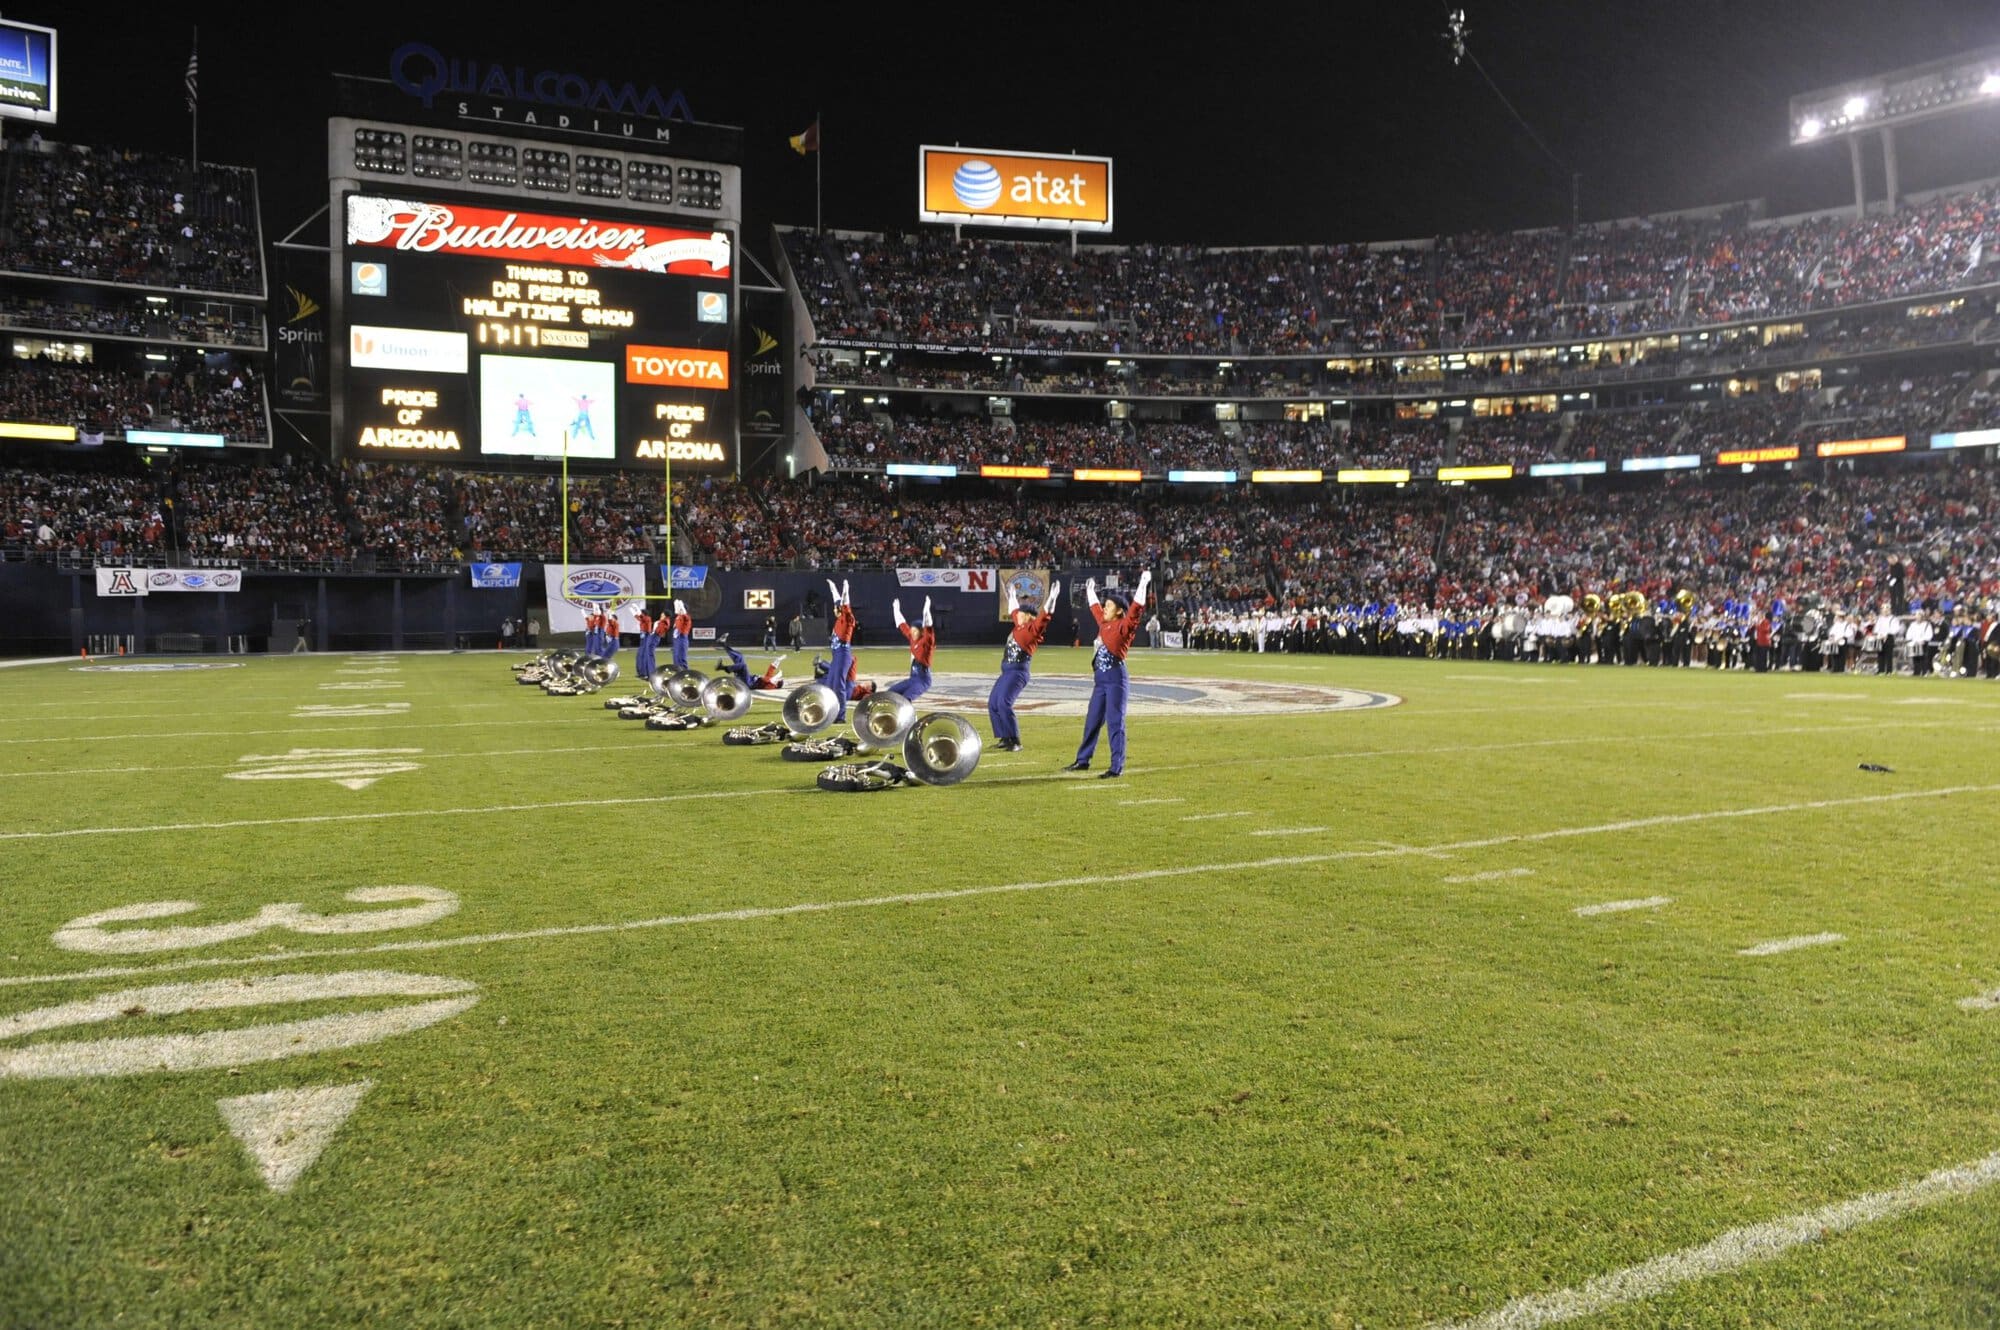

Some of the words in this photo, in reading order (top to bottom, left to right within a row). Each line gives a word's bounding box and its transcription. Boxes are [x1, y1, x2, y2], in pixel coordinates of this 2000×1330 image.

[389, 41, 694, 122] QUALCOMM
[458, 102, 670, 141] STADIUM
[1010, 171, 1087, 207] at&t
[388, 205, 648, 252] Budweiser
[506, 265, 563, 284] THANKS
[568, 270, 589, 286] TO
[492, 281, 521, 299] DR
[528, 284, 601, 306] PEPPER
[463, 298, 571, 323] HALFTIME
[581, 307, 634, 327] SHOW
[278, 326, 324, 344] Sprint
[631, 356, 724, 380] TOYOTA
[744, 357, 782, 375] Sprint
[382, 389, 438, 407] PRIDE
[398, 409, 423, 425] OF
[656, 404, 705, 421] PRIDE
[359, 427, 461, 450] ARIZONA
[669, 423, 692, 438] OF
[636, 439, 725, 461] ARIZONA
[109, 571, 137, 594] A
[969, 571, 988, 590] N
[749, 590, 771, 608] 25
